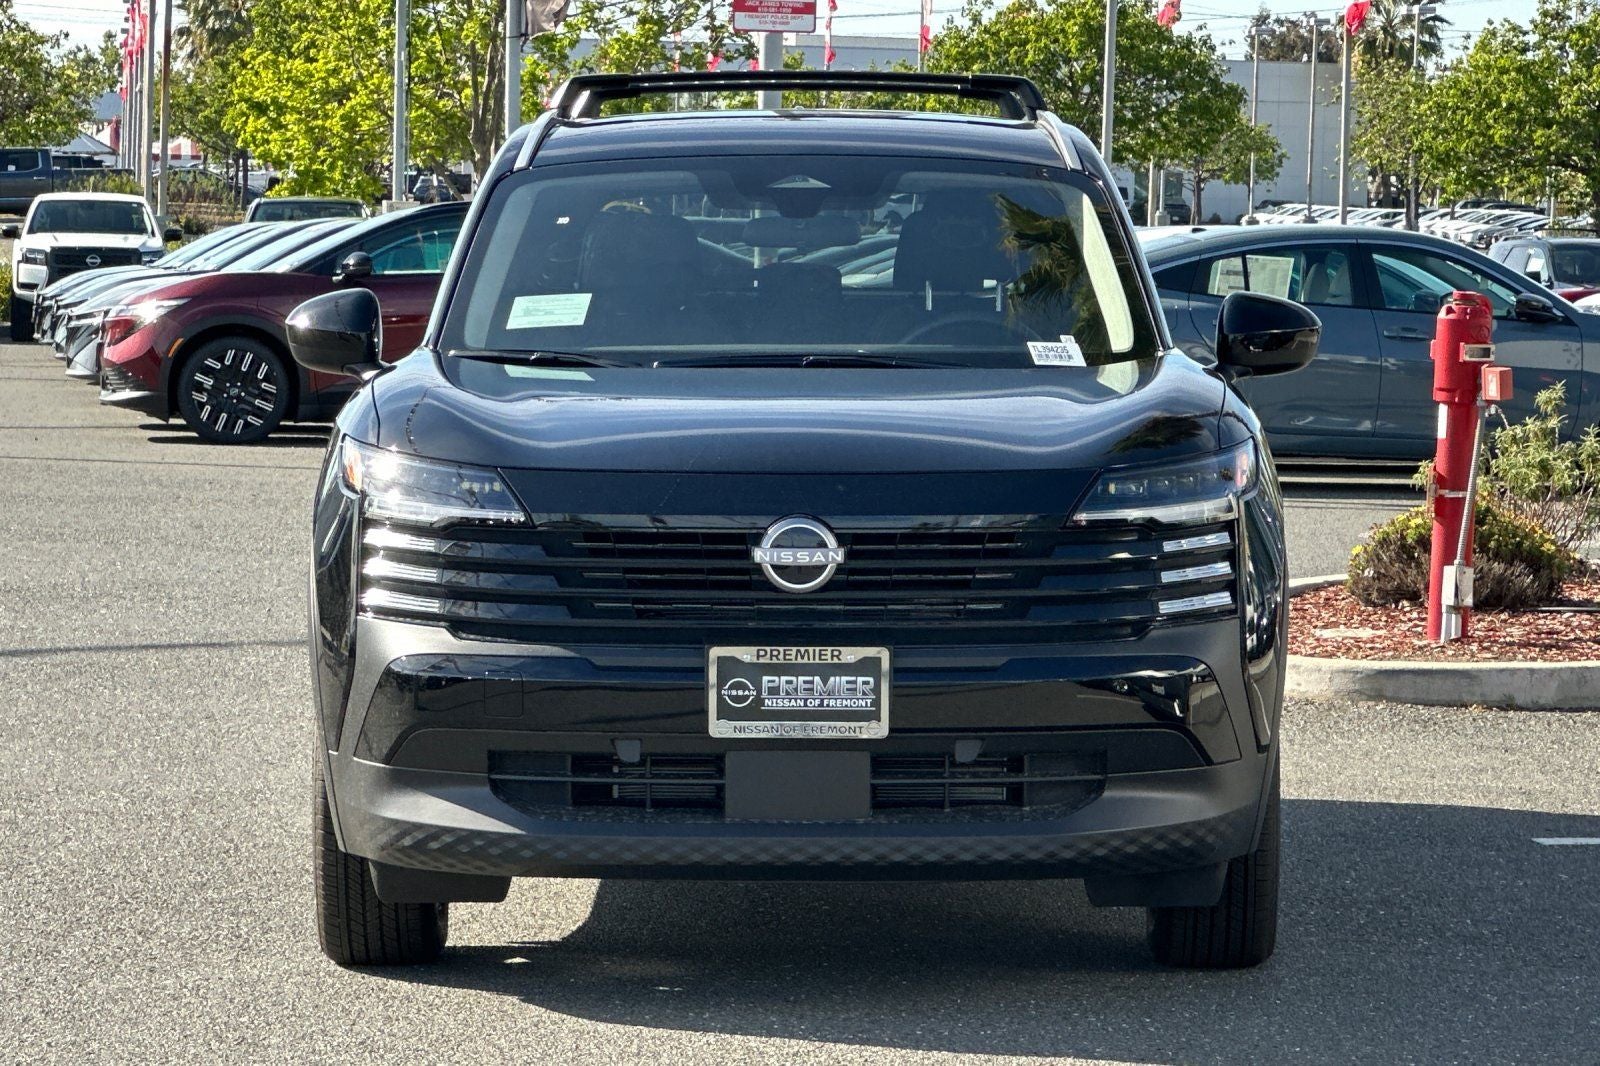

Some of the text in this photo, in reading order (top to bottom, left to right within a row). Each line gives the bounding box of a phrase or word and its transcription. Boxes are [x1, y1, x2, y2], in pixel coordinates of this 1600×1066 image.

[757, 551, 842, 563] NISSAN
[756, 648, 842, 661] PREMIER
[761, 675, 875, 696] PREMIER
[764, 699, 873, 708] NISSAN OF FREMONT
[733, 725, 864, 735] NISSAN OF FREMONT
